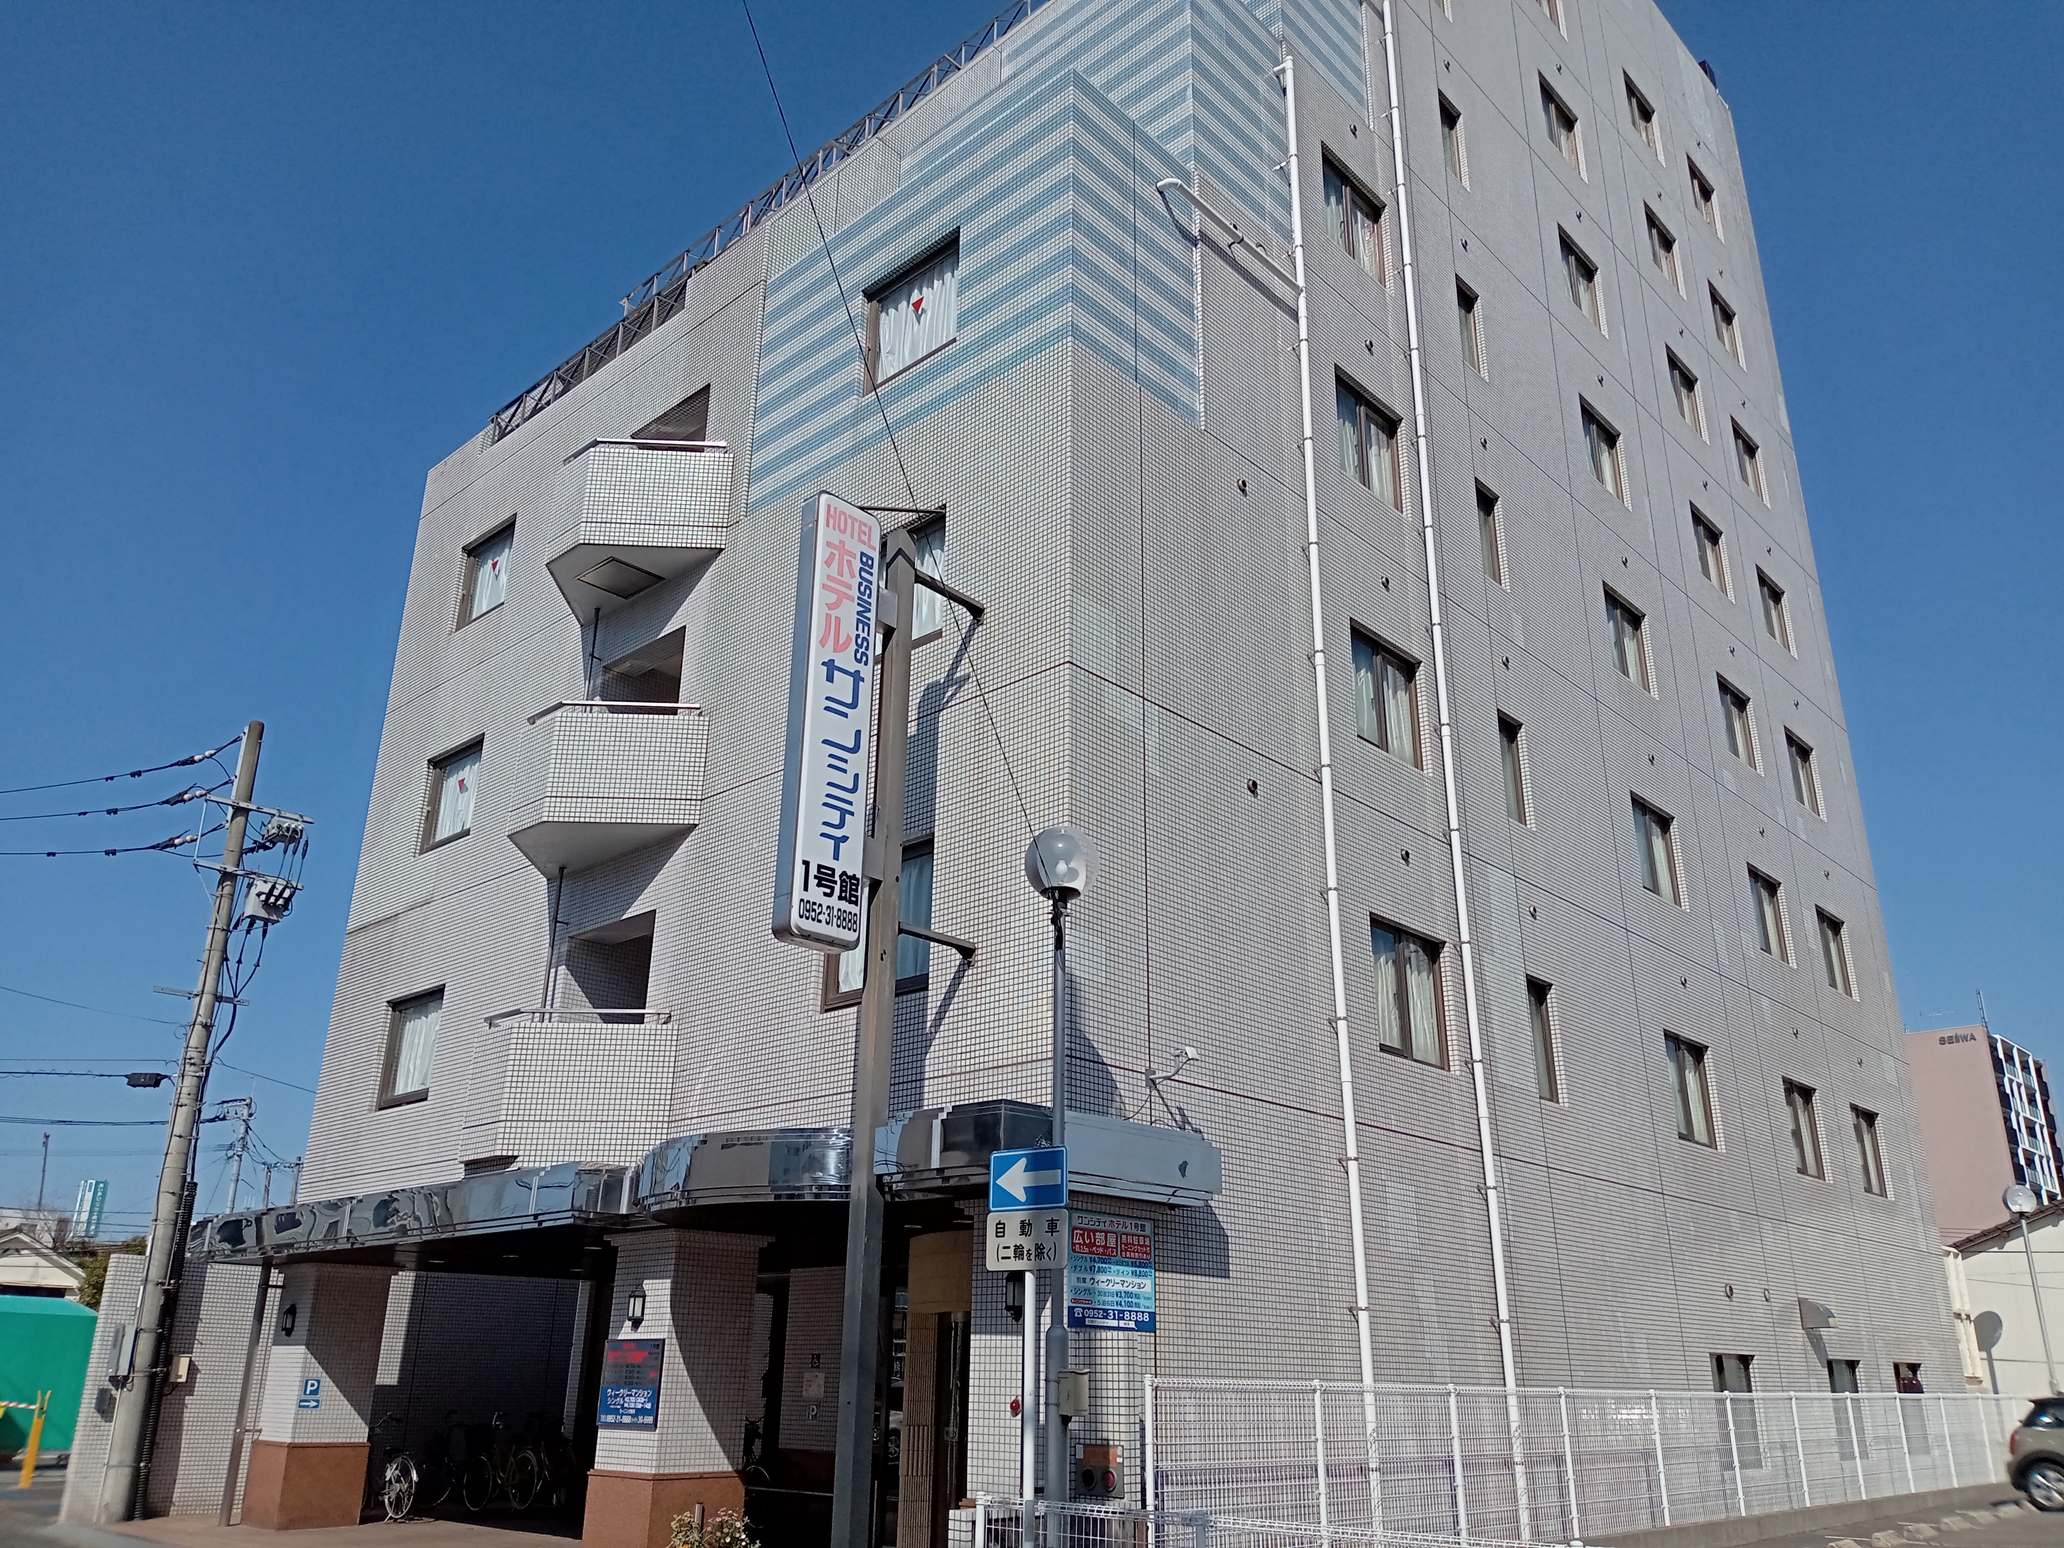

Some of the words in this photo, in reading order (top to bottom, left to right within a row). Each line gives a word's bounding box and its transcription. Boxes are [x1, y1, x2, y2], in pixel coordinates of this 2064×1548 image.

[826, 503, 877, 551] HOTEL
[819, 539, 858, 654] ホテル
[853, 550, 875, 667] BUSINESS
[800, 859, 861, 908] 1号館
[798, 898, 859, 934] 0952-31-8888
[995, 1217, 1060, 1238] 自動車
[1073, 1229, 1117, 1248] 広い部屋
[996, 1241, 1057, 1263] (二輪を除く)
[1089, 1276, 1147, 1290] ウィークリーマンション
[1083, 1308, 1150, 1322] 0952-31-8888
[305, 1380, 319, 1395] P
[606, 1388, 653, 1397] ウィークリーマンション
